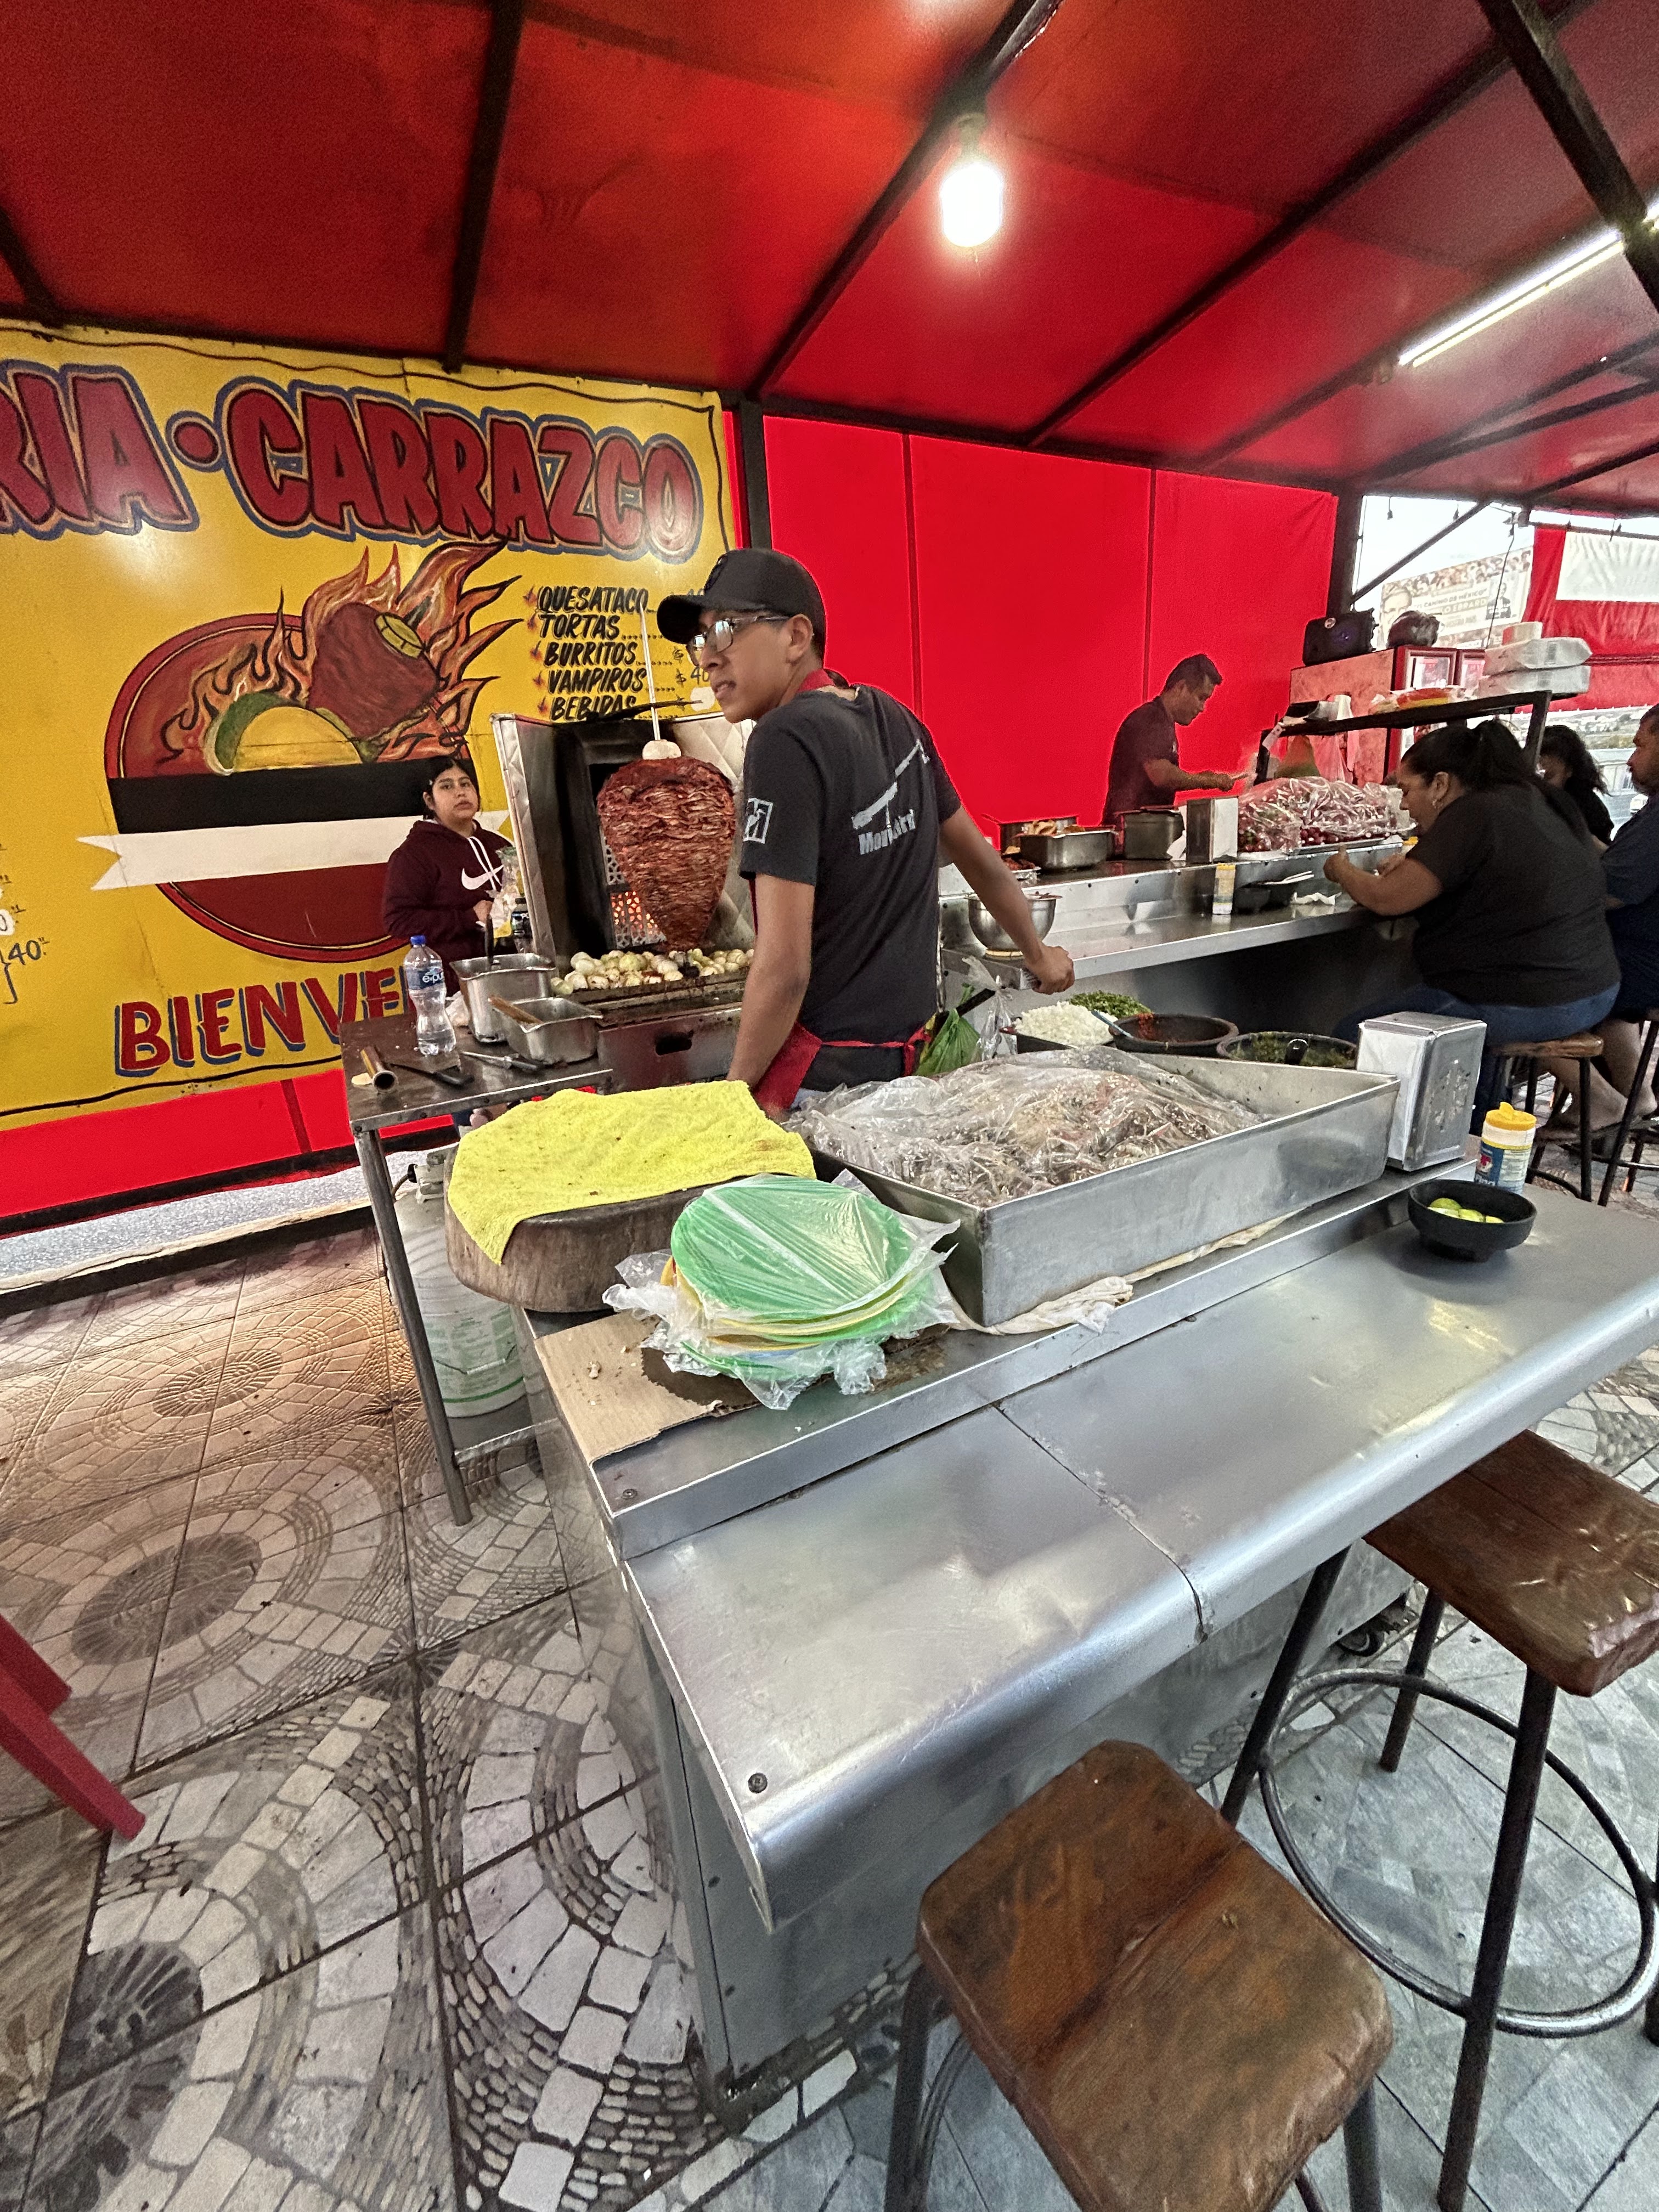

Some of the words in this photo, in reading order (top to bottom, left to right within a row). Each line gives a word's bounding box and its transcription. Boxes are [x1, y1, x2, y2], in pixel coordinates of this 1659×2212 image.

[214, 376, 704, 565] CARRAZCO
[537, 585, 648, 613] QUESATACO
[538, 614, 620, 640] TORTAS
[543, 641, 639, 667] BURRITOS
[548, 668, 647, 695] VAMPIROS
[550, 694, 637, 721] BEBIDAS
[115, 967, 413, 1076] BIENVE
